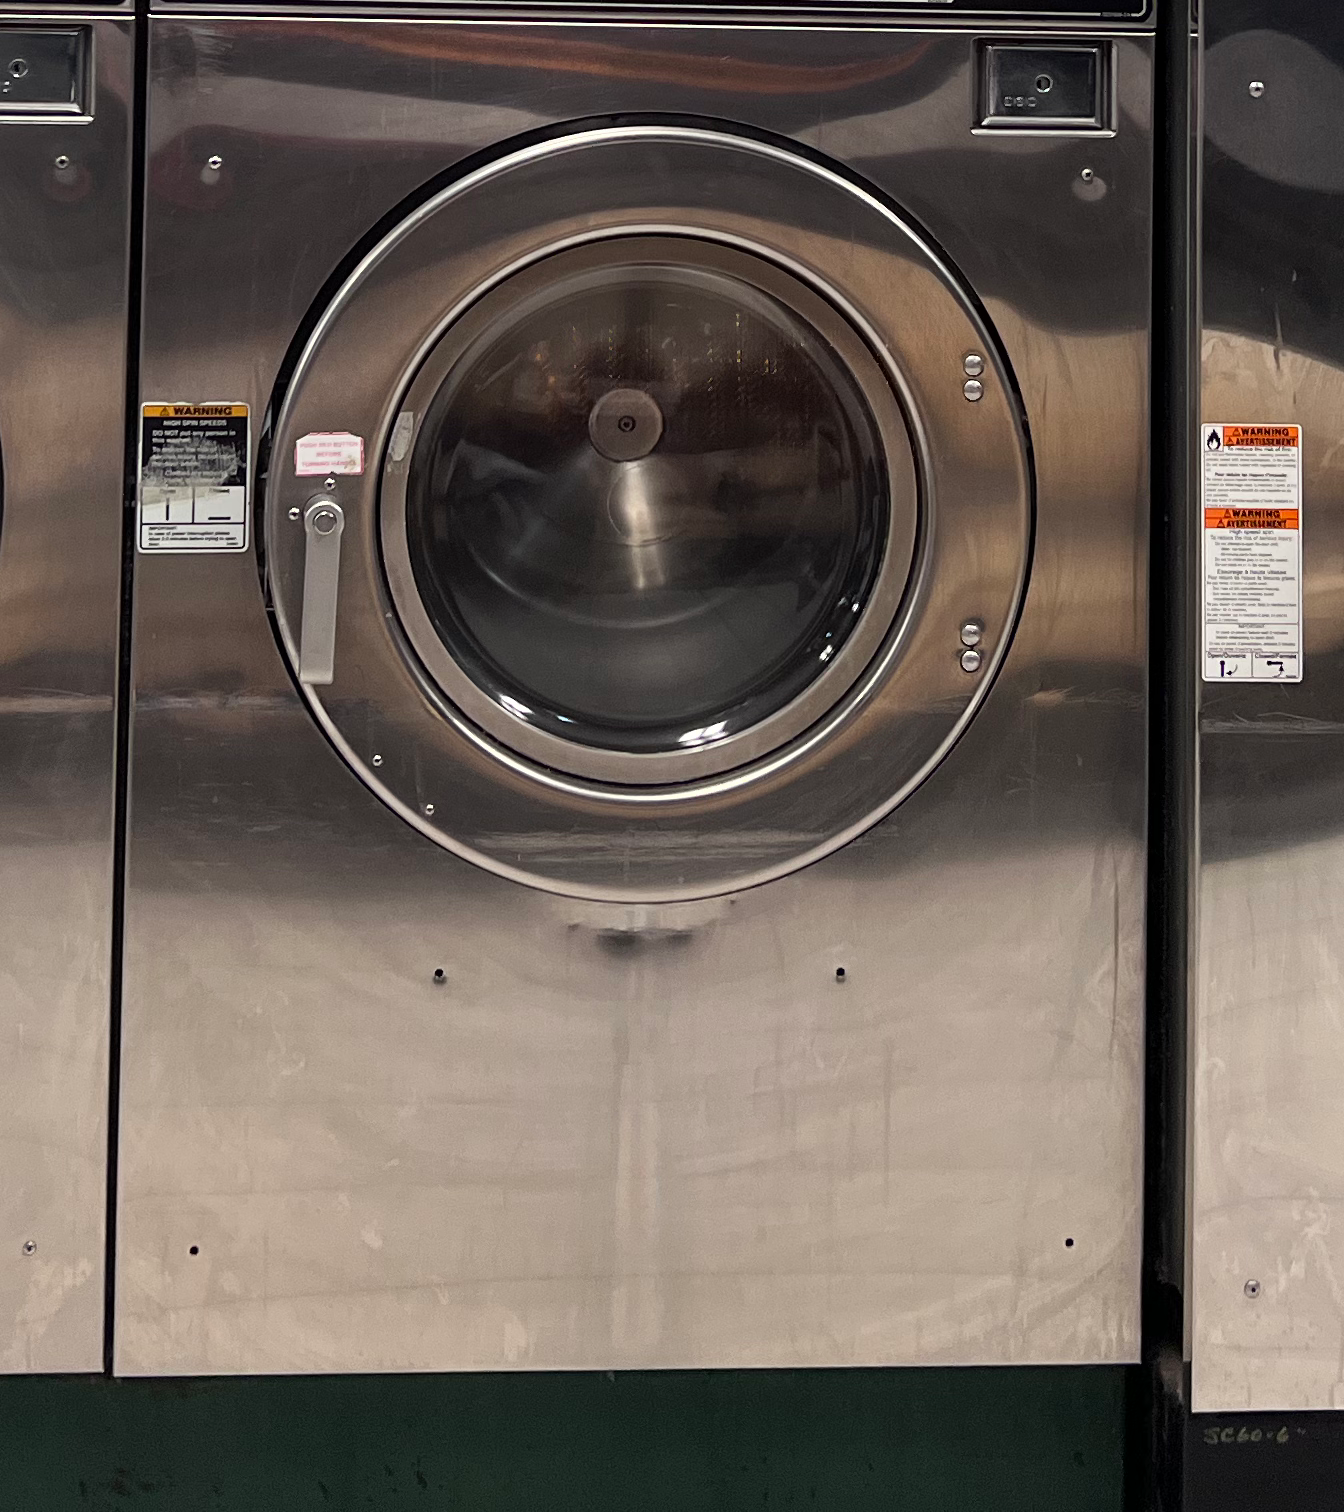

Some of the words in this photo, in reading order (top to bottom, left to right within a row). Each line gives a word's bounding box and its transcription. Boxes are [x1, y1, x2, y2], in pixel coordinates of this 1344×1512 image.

[173, 406, 233, 416] WARNING
[1240, 428, 1289, 436] WARNING
[1235, 437, 1296, 445] AVERTISSEMENT
[1232, 509, 1281, 518] WARNING
[1226, 519, 1287, 528] AVERTISSEMENT
